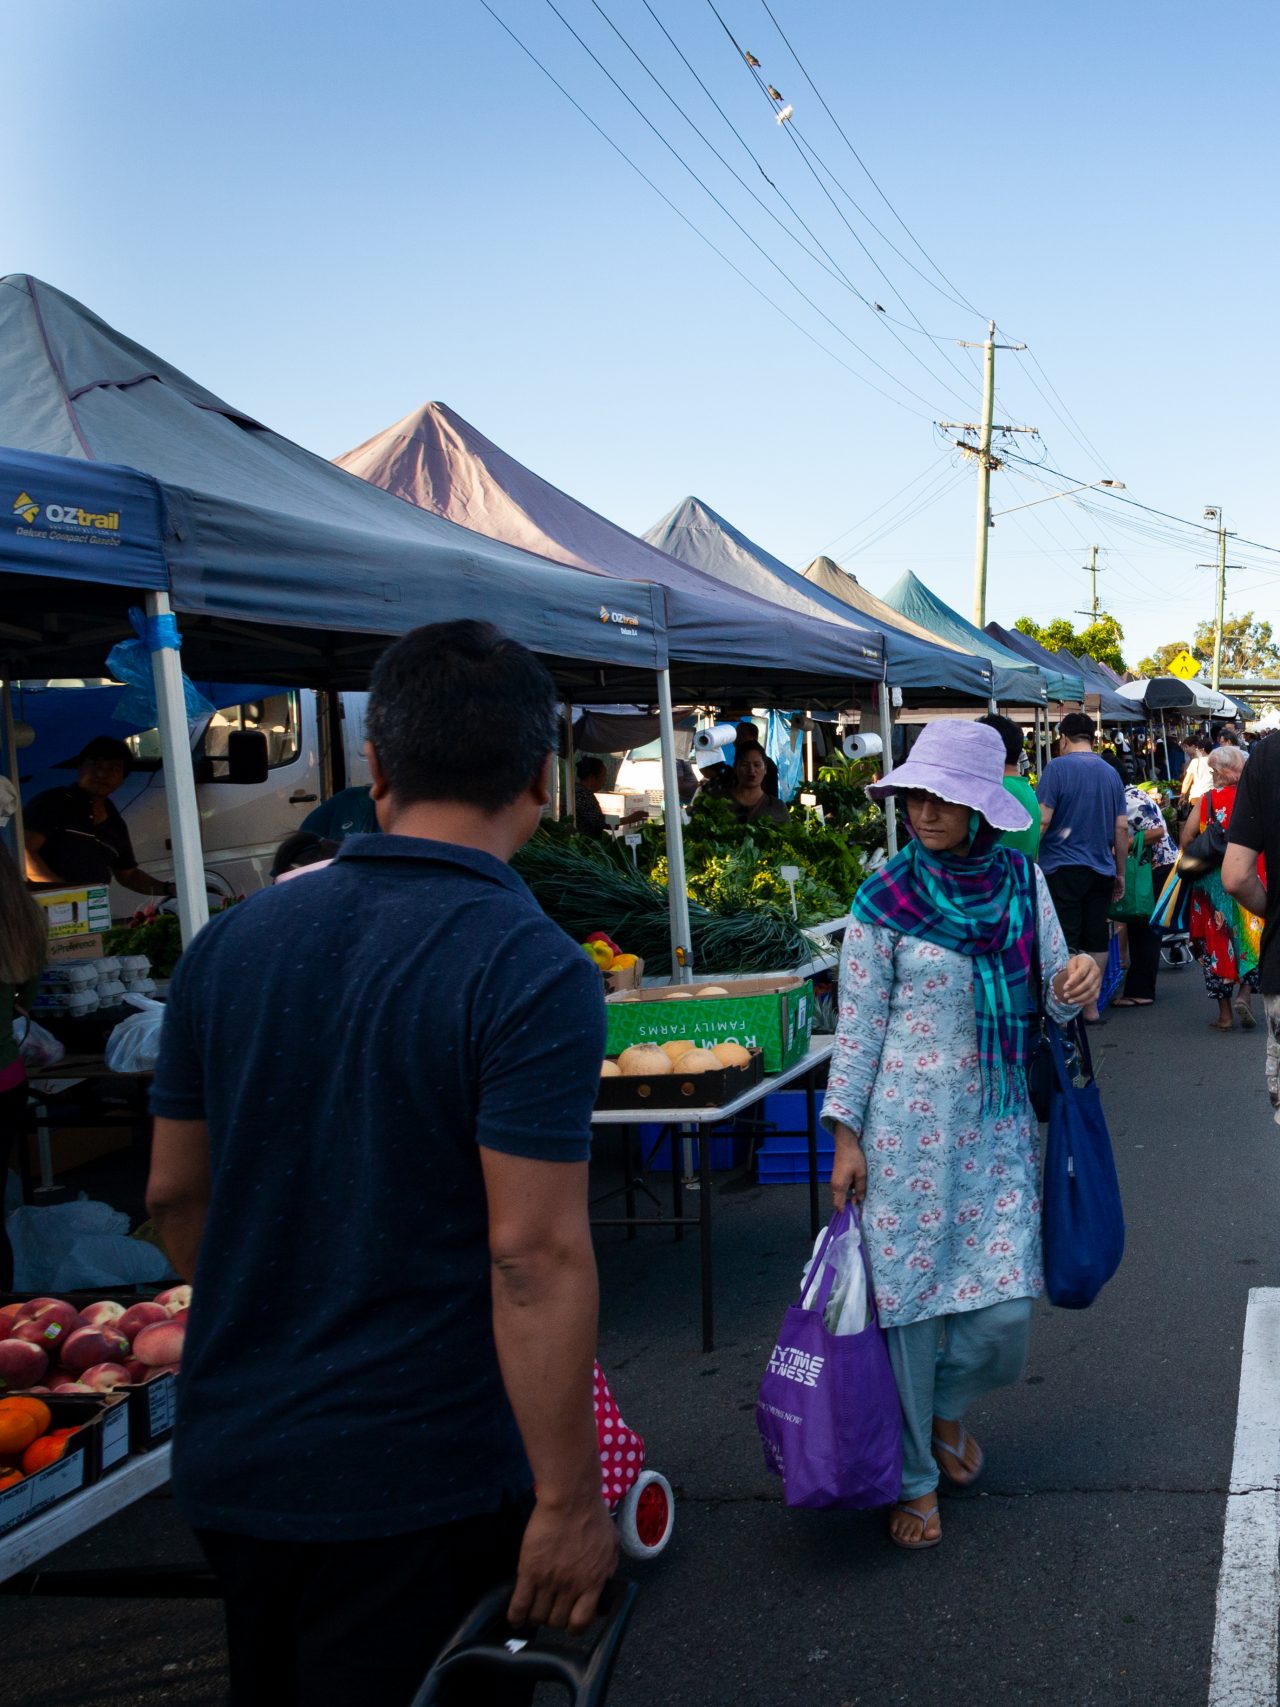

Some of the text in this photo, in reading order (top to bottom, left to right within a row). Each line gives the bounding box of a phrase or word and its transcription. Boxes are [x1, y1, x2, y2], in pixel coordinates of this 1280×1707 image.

[46, 504, 119, 530] OZtrail
[16, 527, 48, 539] Deluxe
[49, 531, 87, 544] Compact
[639, 1020, 745, 1036] FAMILY FARMS
